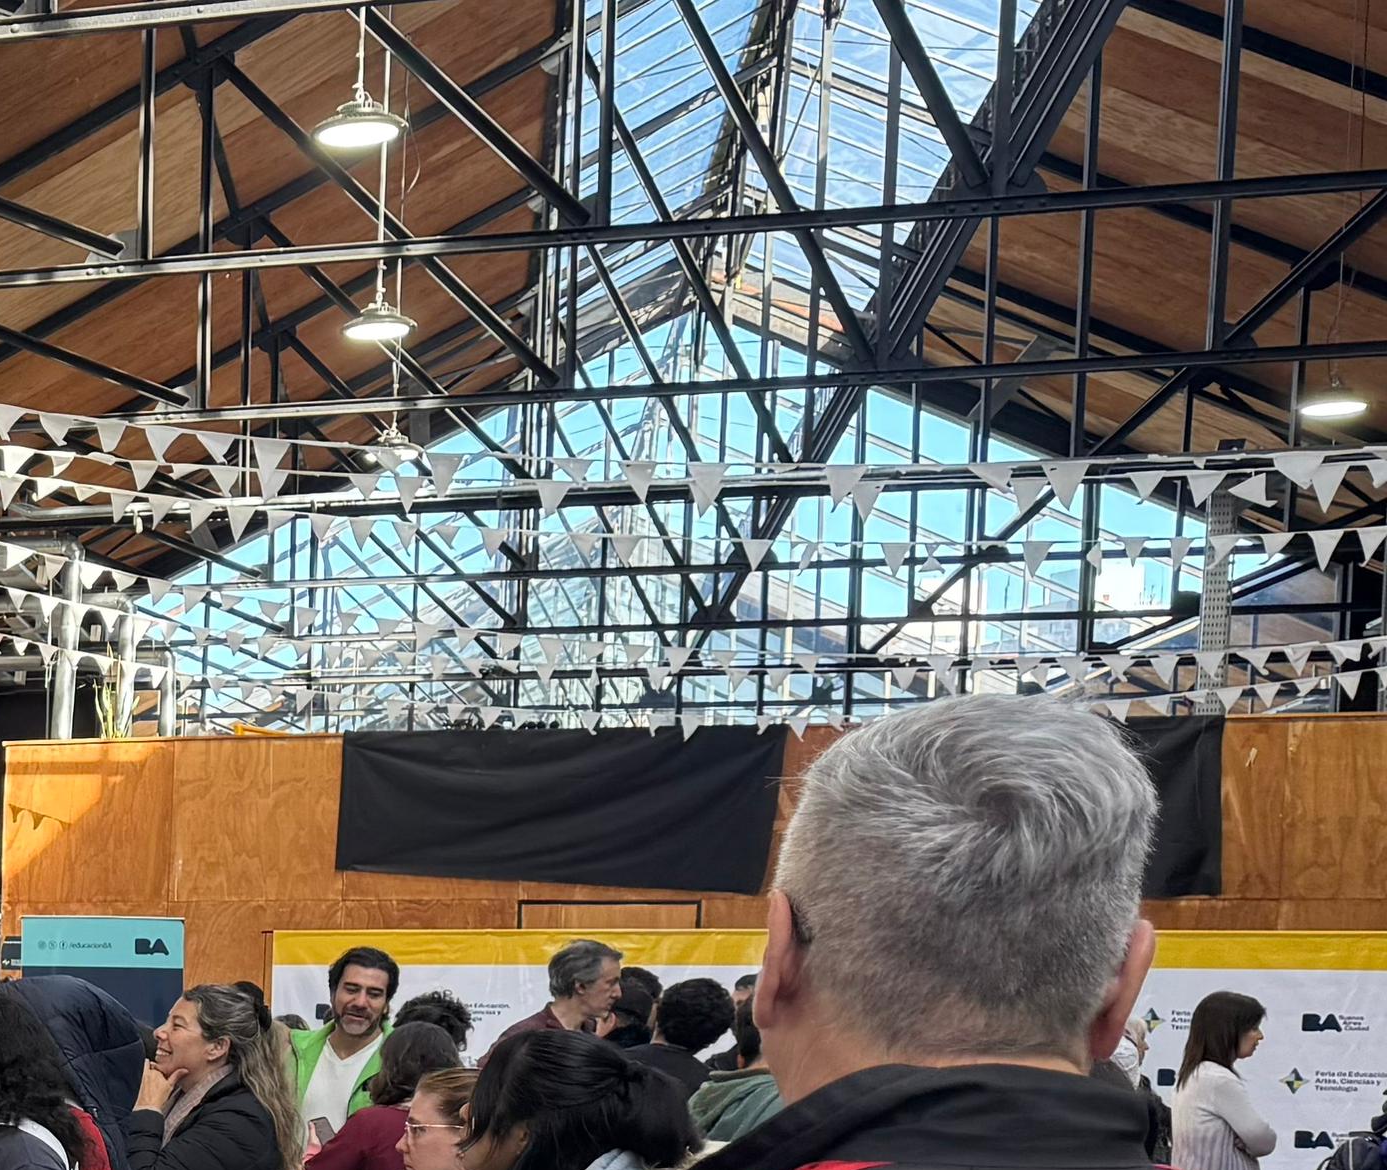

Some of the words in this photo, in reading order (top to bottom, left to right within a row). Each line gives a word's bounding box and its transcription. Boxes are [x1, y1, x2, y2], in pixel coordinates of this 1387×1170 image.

[134, 938, 170, 956] BA
[1301, 1013, 1343, 1033] BA
[1294, 1130, 1334, 1150] BA
